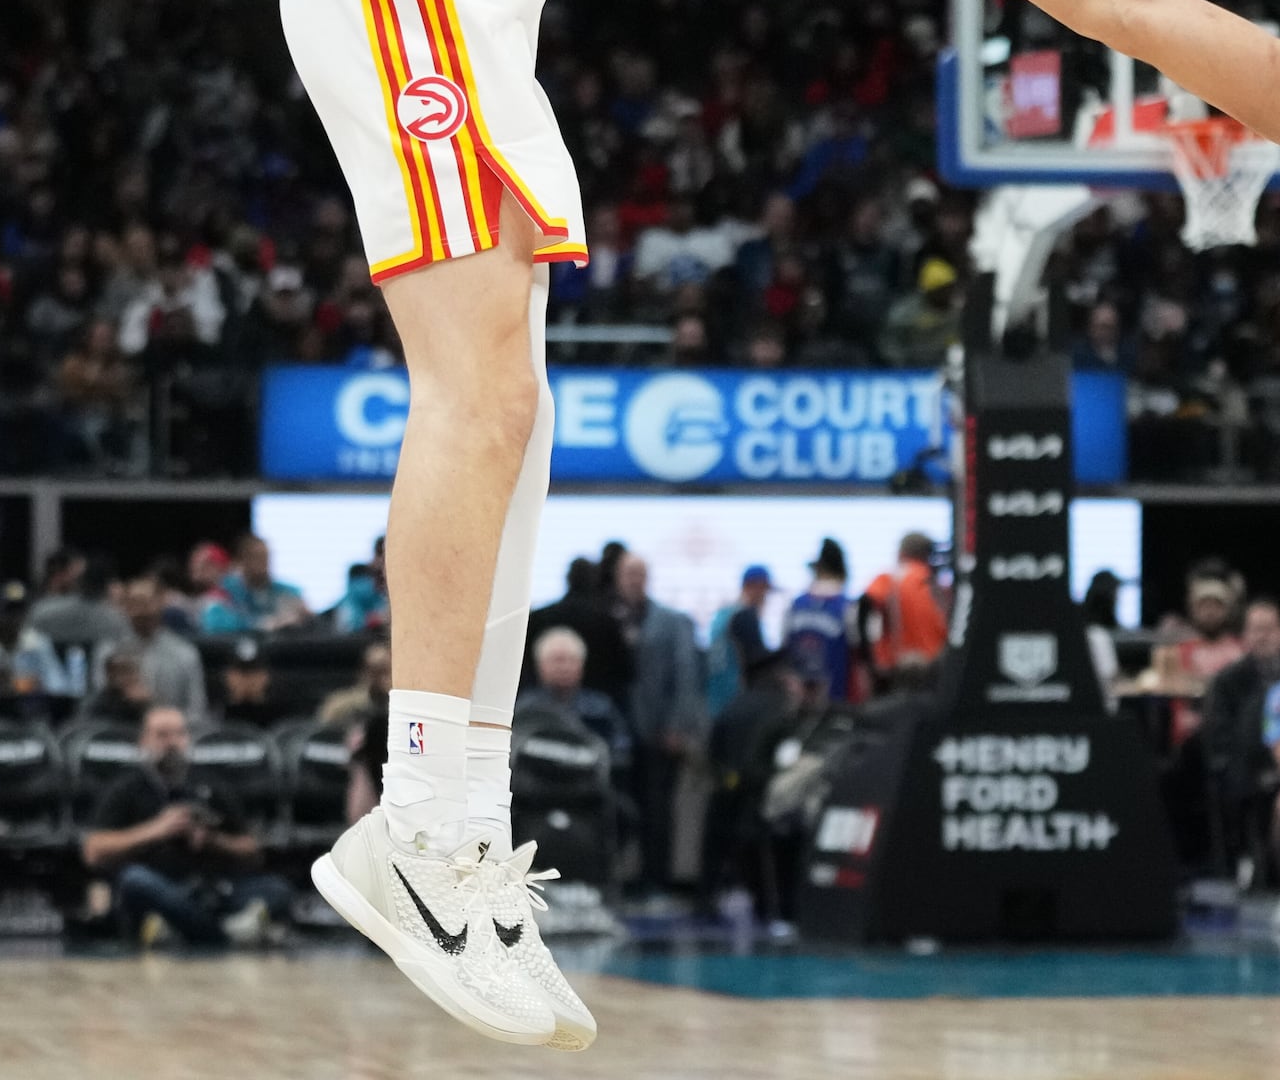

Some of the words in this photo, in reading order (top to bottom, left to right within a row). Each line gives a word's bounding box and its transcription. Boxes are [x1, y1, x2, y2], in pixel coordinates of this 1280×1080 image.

[736, 375, 942, 430] COURT
[736, 430, 897, 480] CLUB
[942, 775, 1058, 811] FORD
